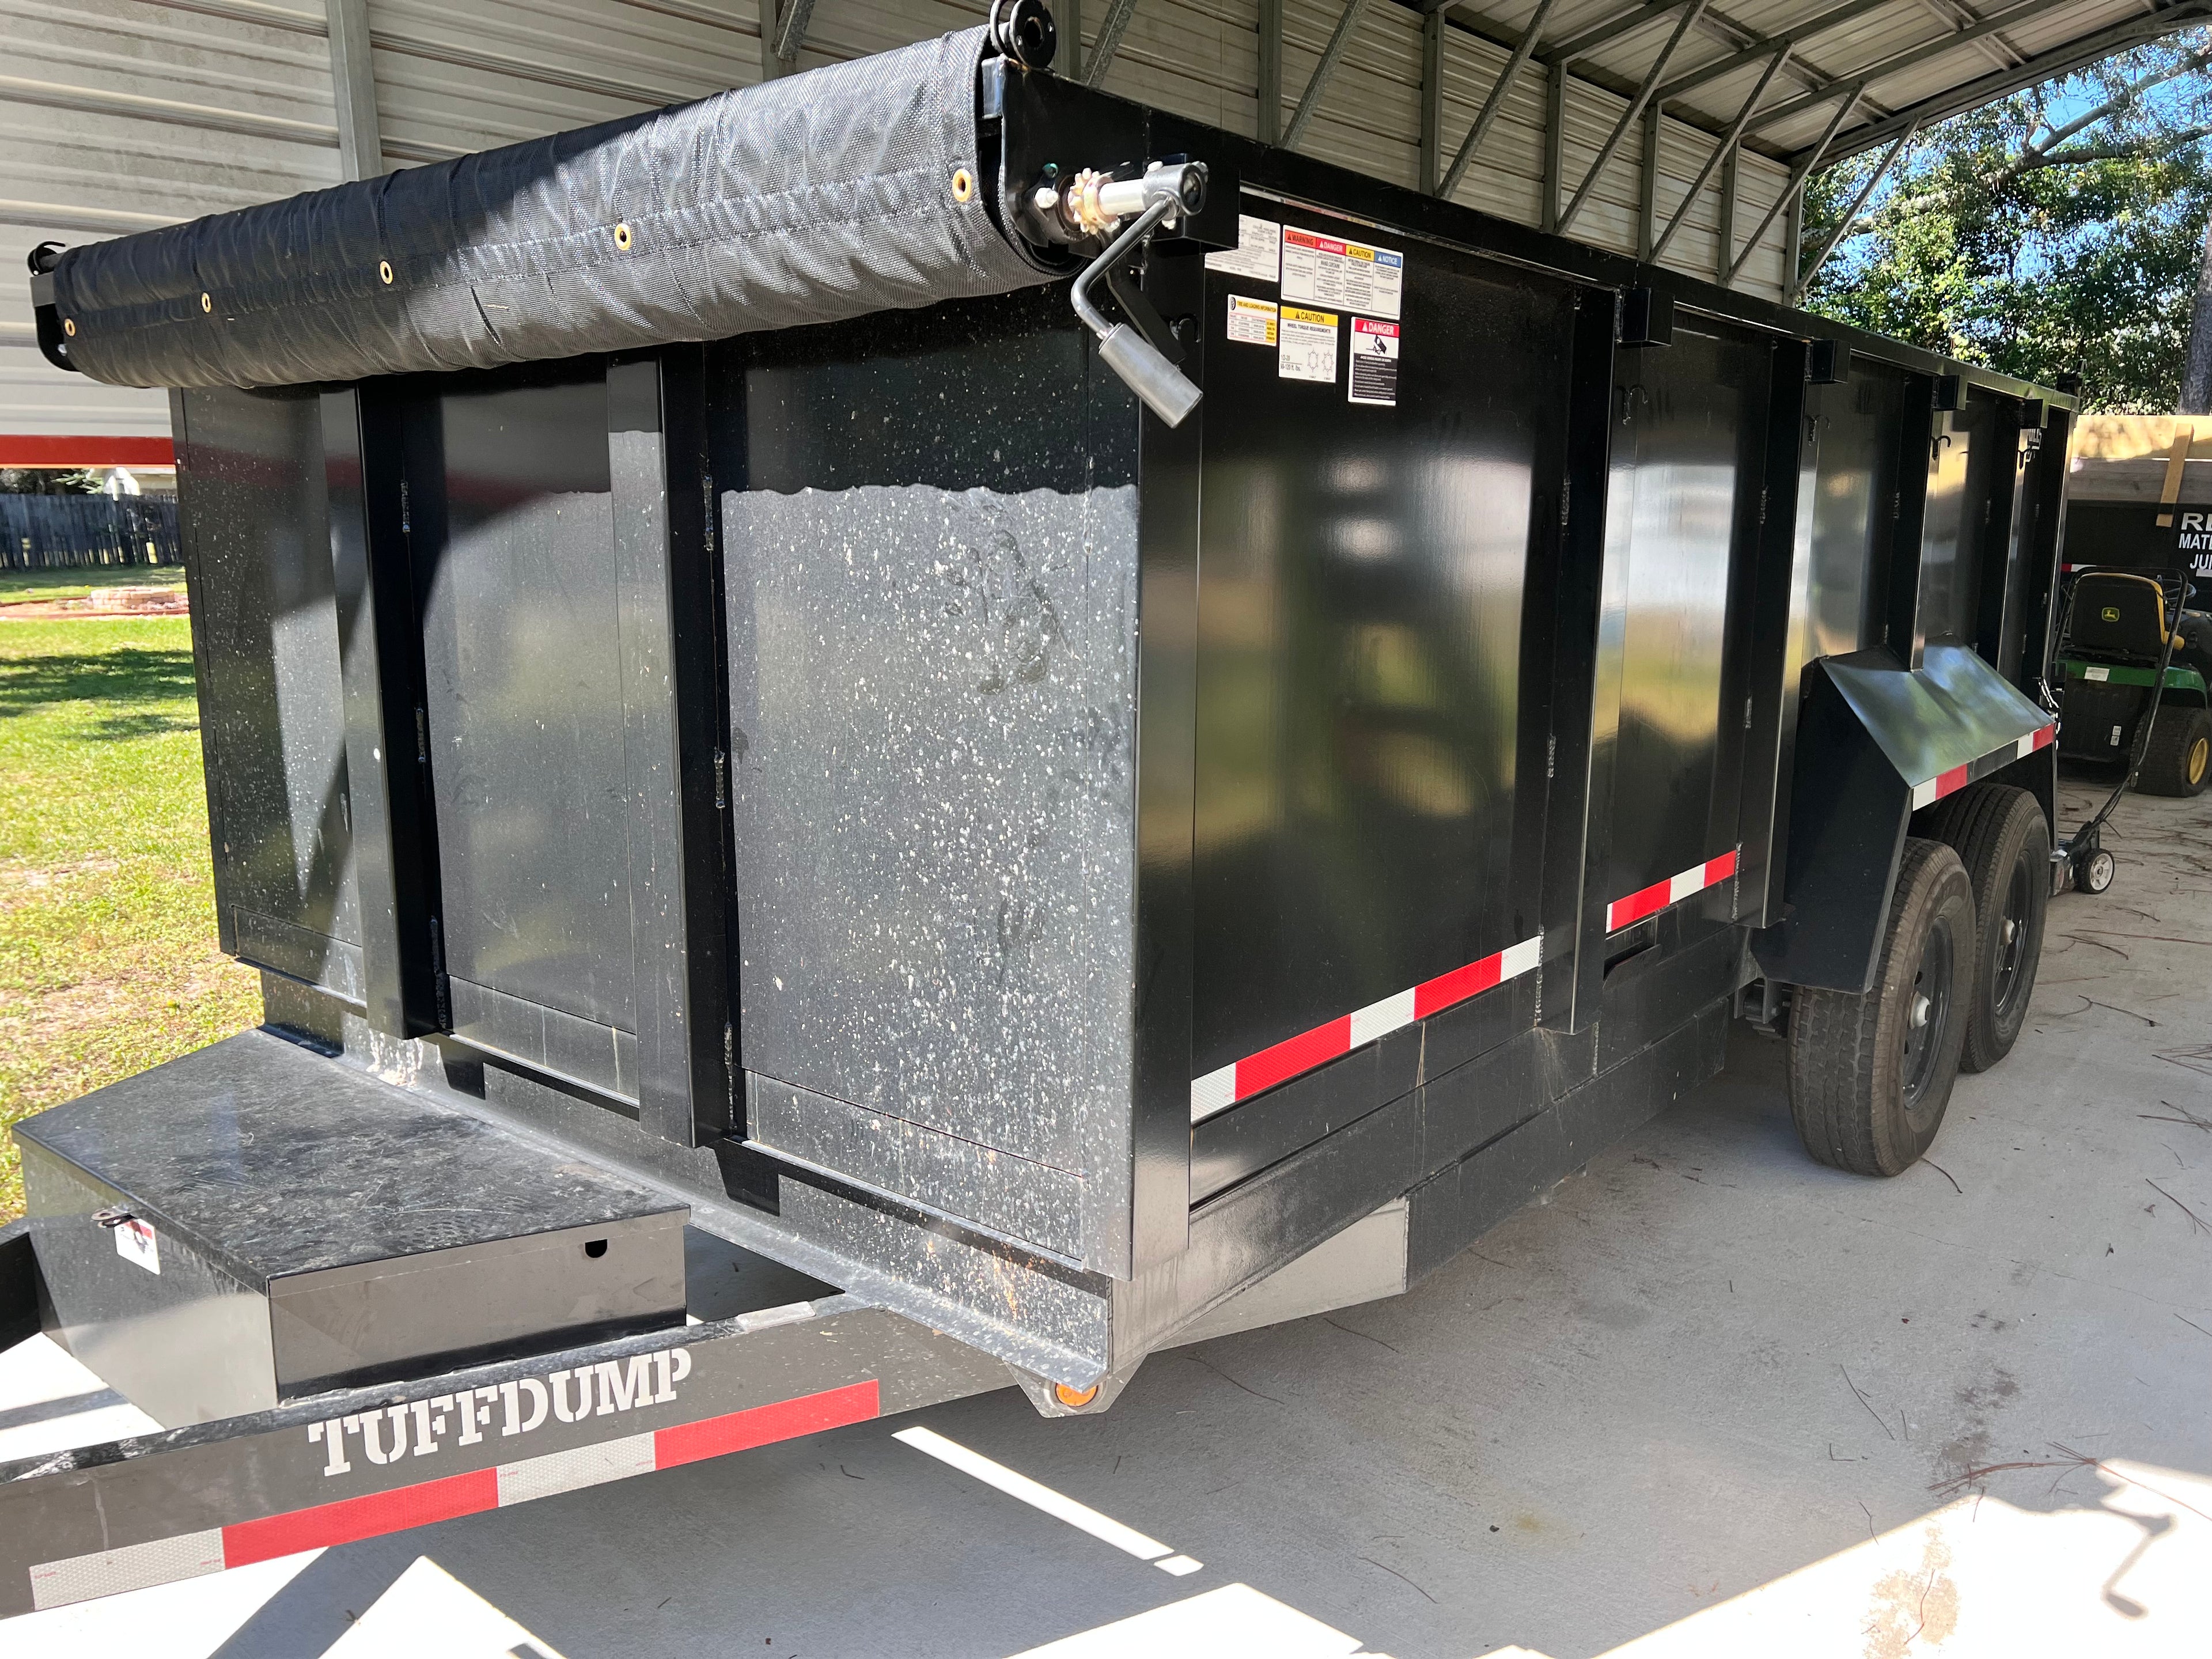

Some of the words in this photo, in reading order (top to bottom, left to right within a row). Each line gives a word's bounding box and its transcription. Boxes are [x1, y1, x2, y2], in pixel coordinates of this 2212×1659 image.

[1292, 234, 1313, 245] WARNING
[1324, 243, 1343, 253] DANGER
[1353, 248, 1371, 258] CAUTION
[1382, 255, 1397, 265] NOTICE
[1301, 312, 1324, 323] CAUTION
[1369, 322, 1394, 336] DANGER
[308, 1347, 691, 1477] TUFFDUMP
